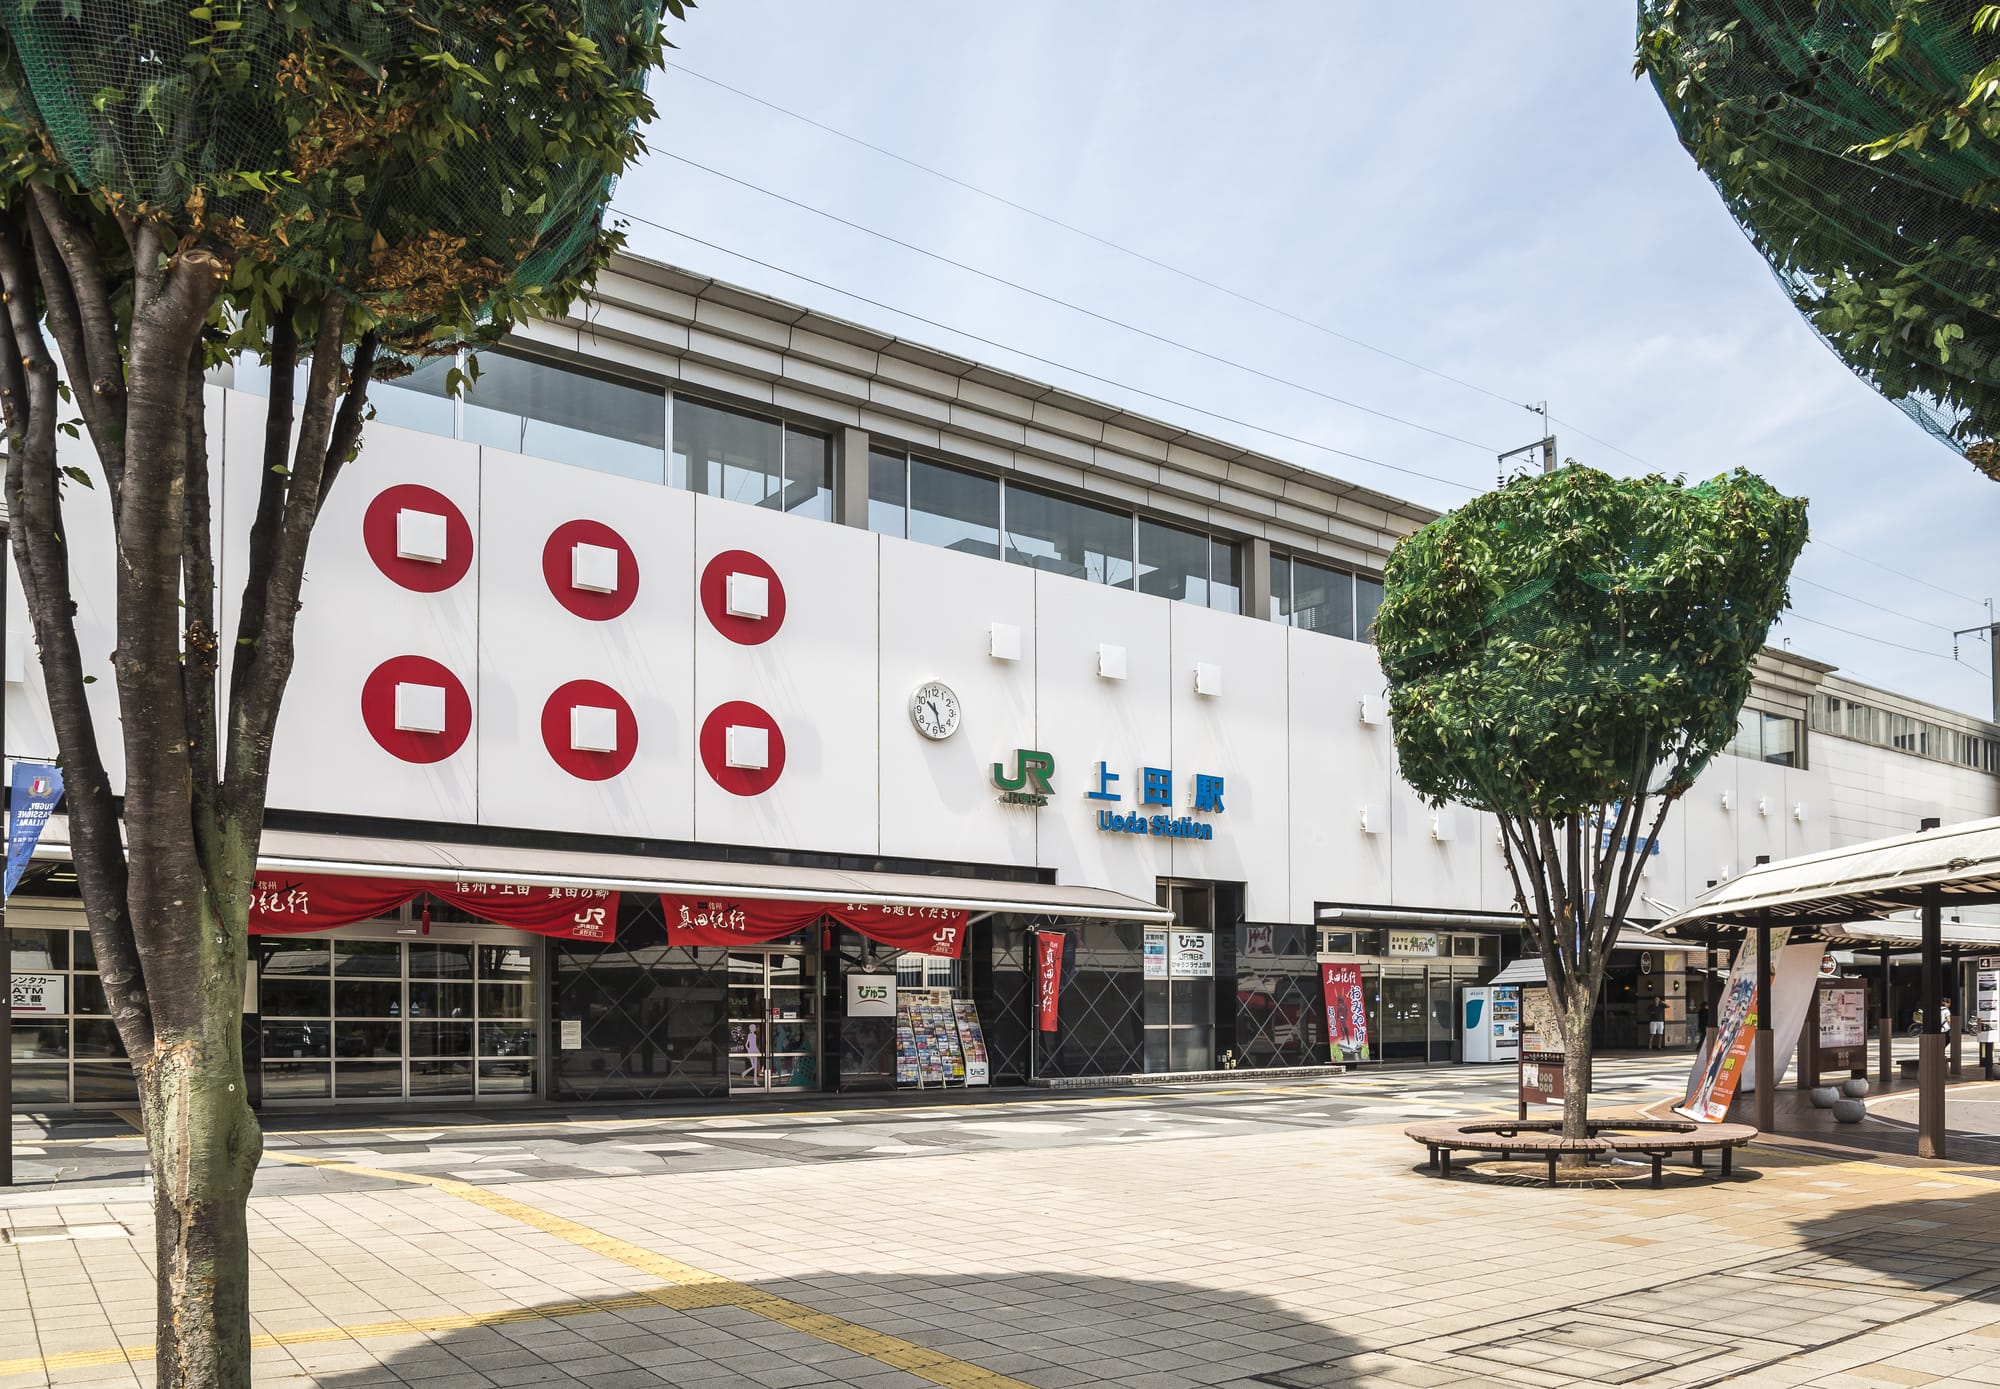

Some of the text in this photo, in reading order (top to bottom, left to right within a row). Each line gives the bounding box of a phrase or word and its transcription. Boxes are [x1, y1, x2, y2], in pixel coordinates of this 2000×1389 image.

[925, 690, 931, 698] 11
[931, 689, 939, 697] 12
[941, 692, 944, 700] 1
[918, 696, 926, 704] 10
[945, 699, 951, 707] 2
[916, 705, 922, 713] 9
[949, 709, 954, 717] 3
[919, 715, 925, 723] 8
[932, 726, 938, 734] 6
[941, 725, 946, 733] 5
[990, 749, 1055, 795] JR
[1085, 761, 1224, 813] 上田駅
[1097, 810, 1213, 841] Ueda Station
[455, 882, 530, 896] 信州・上田
[574, 907, 606, 925] JR
[882, 904, 960, 919] お越しください
[678, 905, 745, 930] 真田紀行
[933, 928, 956, 942] JR
[1178, 935, 1205, 948] びゅう
[1981, 959, 1988, 967] 4
[1042, 948, 1054, 1013] 真田紀行
[858, 985, 887, 999] びゅう
[13, 995, 42, 1003] 交番
[1350, 985, 1366, 1043] おみやげ
